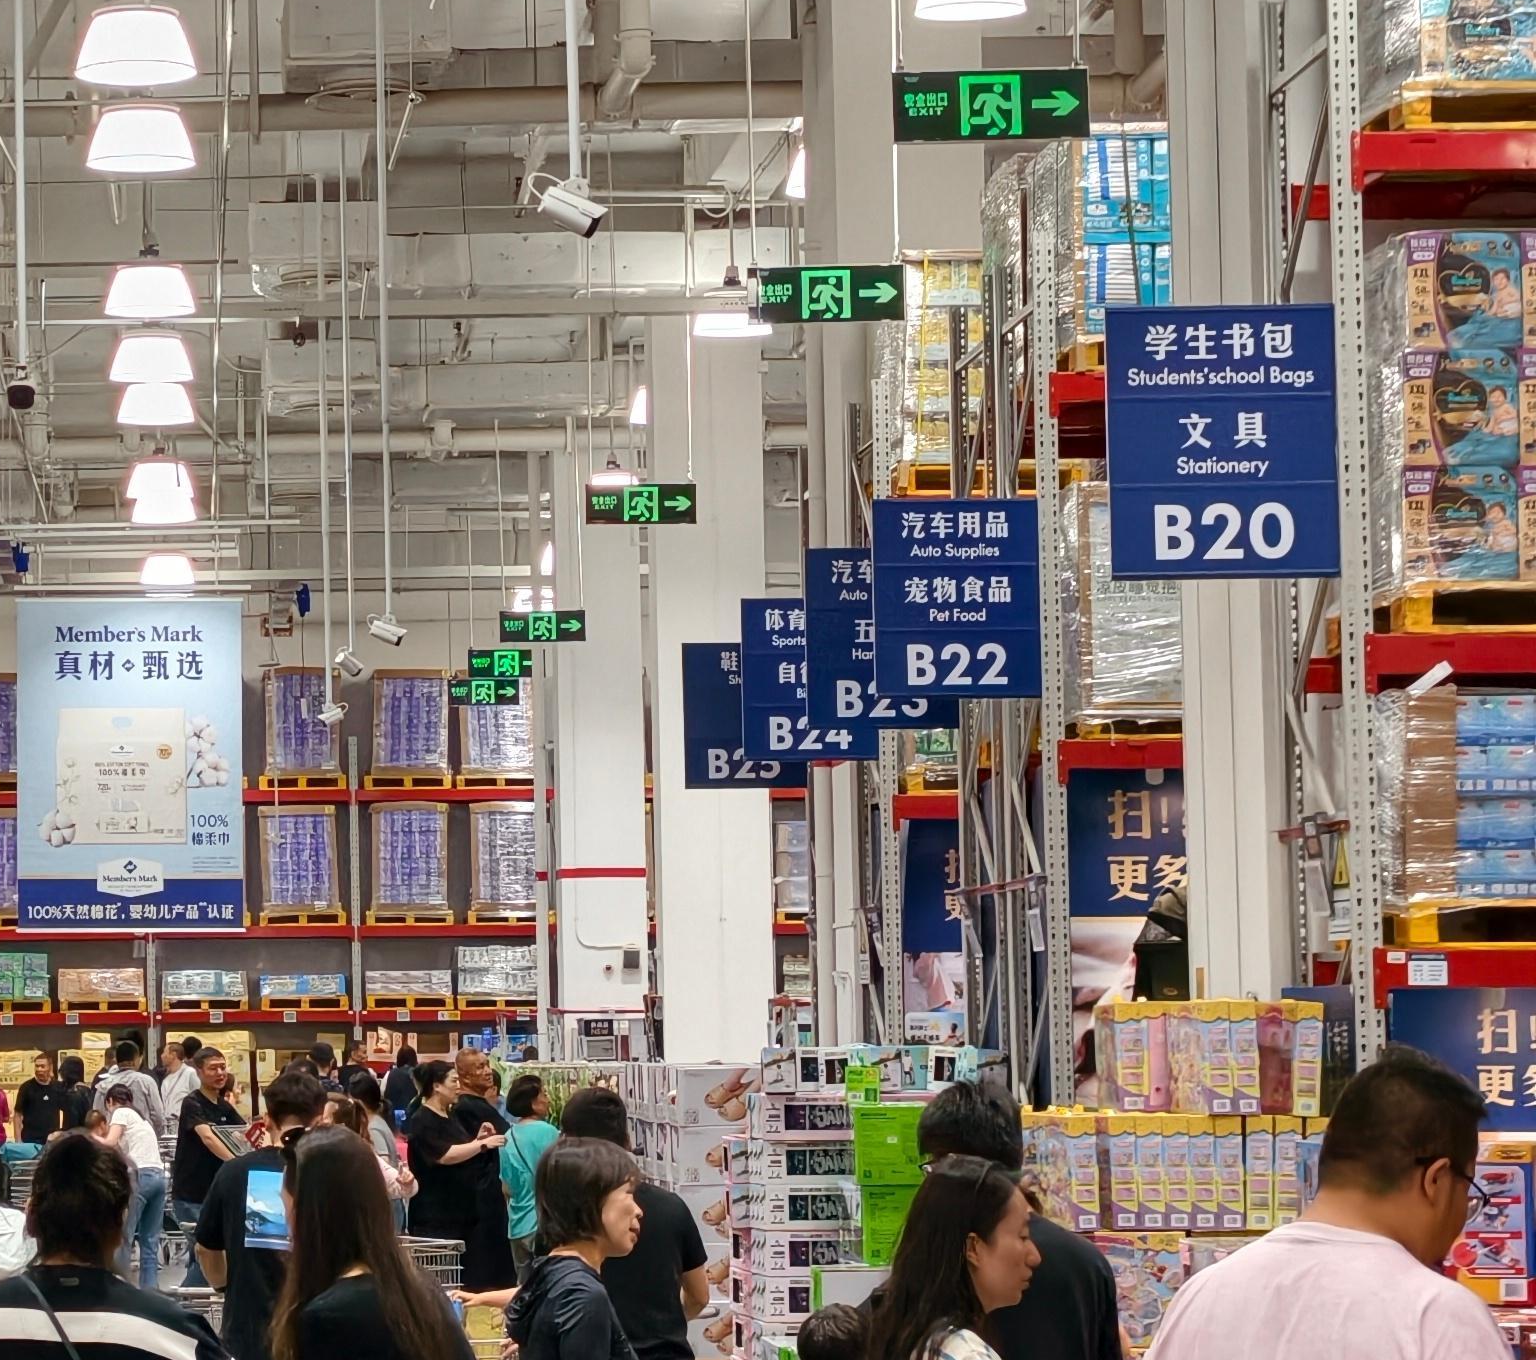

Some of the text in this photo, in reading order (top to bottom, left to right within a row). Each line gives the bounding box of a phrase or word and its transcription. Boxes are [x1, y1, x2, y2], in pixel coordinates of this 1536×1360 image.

[908, 107, 944, 116] EXIT
[1144, 322, 1294, 361] 学生书包
[1269, 365, 1315, 388] Bags
[1178, 411, 1267, 449] 文具
[1176, 456, 1270, 478] Stationery
[901, 511, 1009, 539] 汽车用品
[1154, 502, 1295, 561] B20
[910, 543, 1000, 560] Auto Supplies
[831, 559, 873, 584] 汽车
[839, 589, 868, 601] Auto
[904, 576, 1012, 604] 宠物食品
[764, 608, 805, 631] 体育
[928, 608, 986, 622] Pet Food
[55, 624, 203, 643] Member's Mark
[771, 634, 806, 648] Sports
[854, 619, 874, 643] 五
[54, 650, 203, 681] 真材 甄选
[720, 651, 739, 672] 鞋
[852, 648, 874, 660] Har
[906, 643, 1009, 686] B22
[190, 814, 229, 828] 100%
[1107, 789, 1186, 840] 扫!
